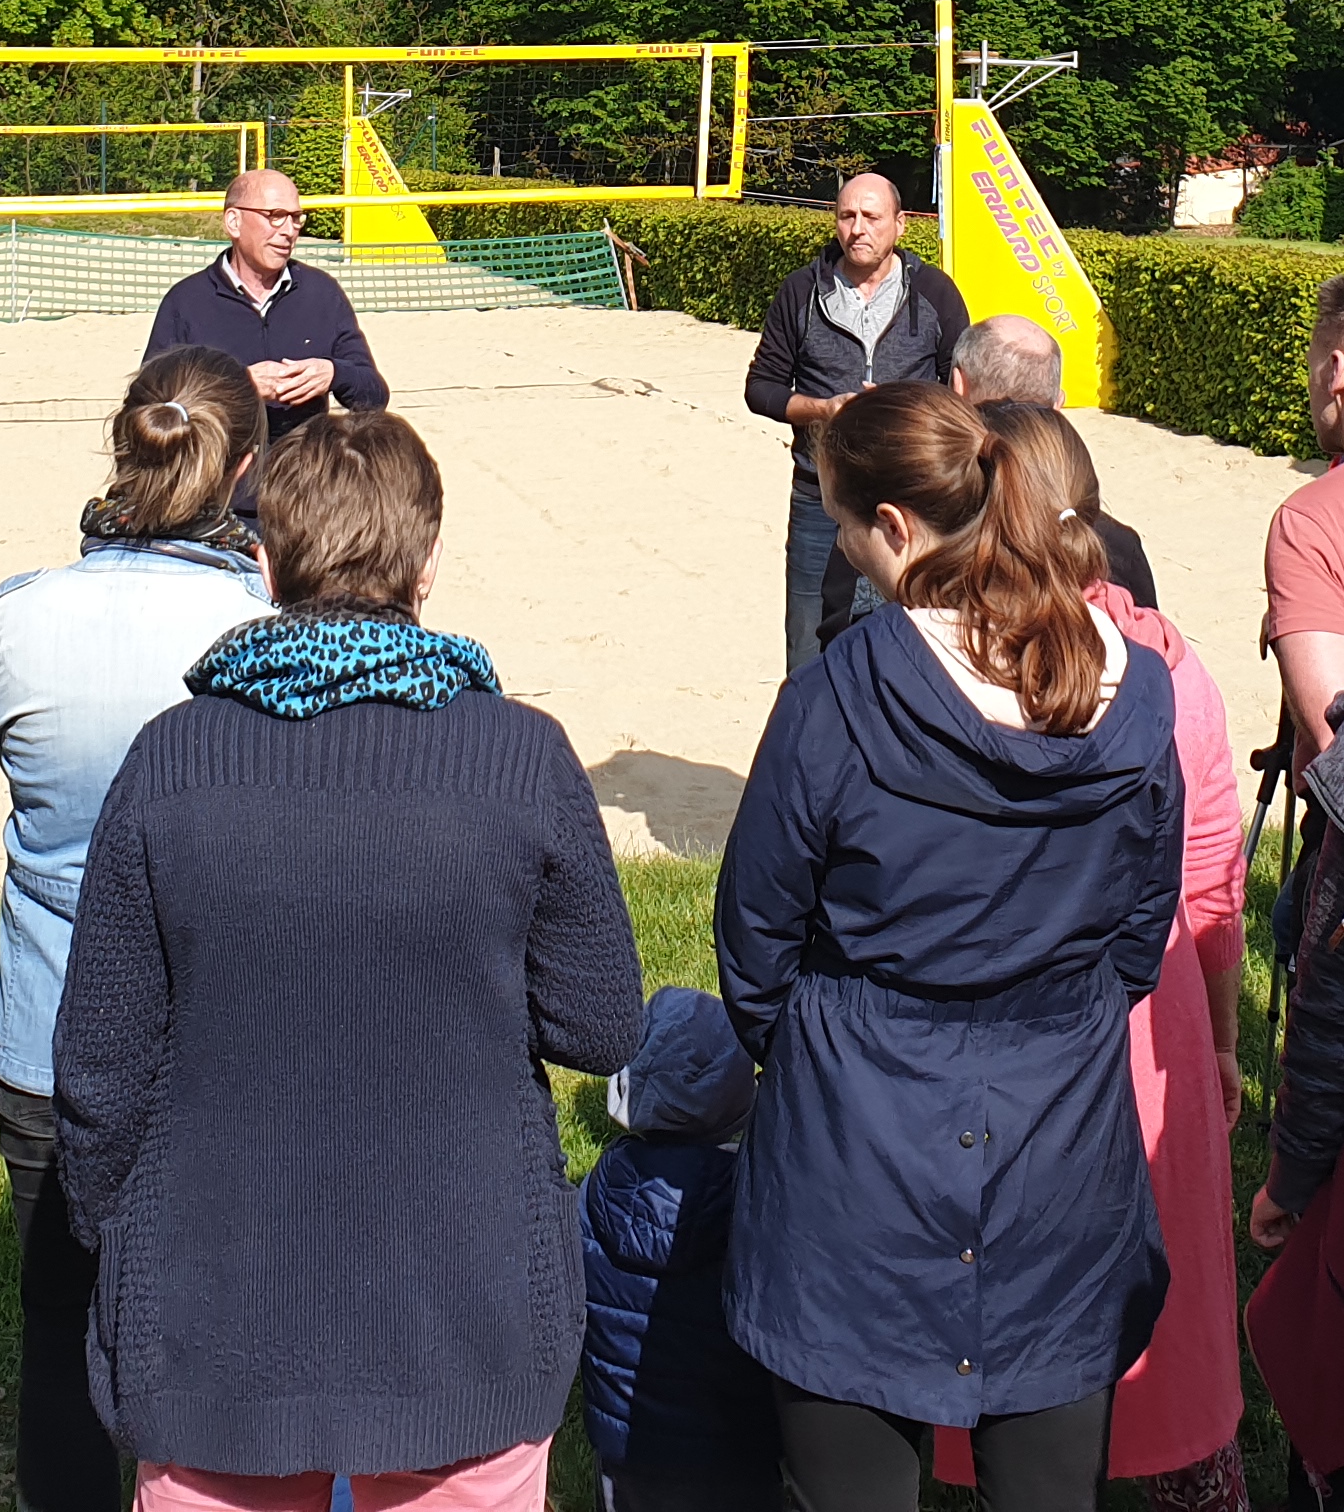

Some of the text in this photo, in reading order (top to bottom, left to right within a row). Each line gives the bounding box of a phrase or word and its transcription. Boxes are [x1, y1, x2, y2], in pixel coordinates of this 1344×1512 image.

[163, 49, 248, 58] FUNTEC
[406, 48, 486, 57] FUNTEC
[356, 145, 390, 193] ERHARD
[970, 118, 1060, 259] FUNTEC
[970, 171, 1078, 334] ERHARD SPORT
